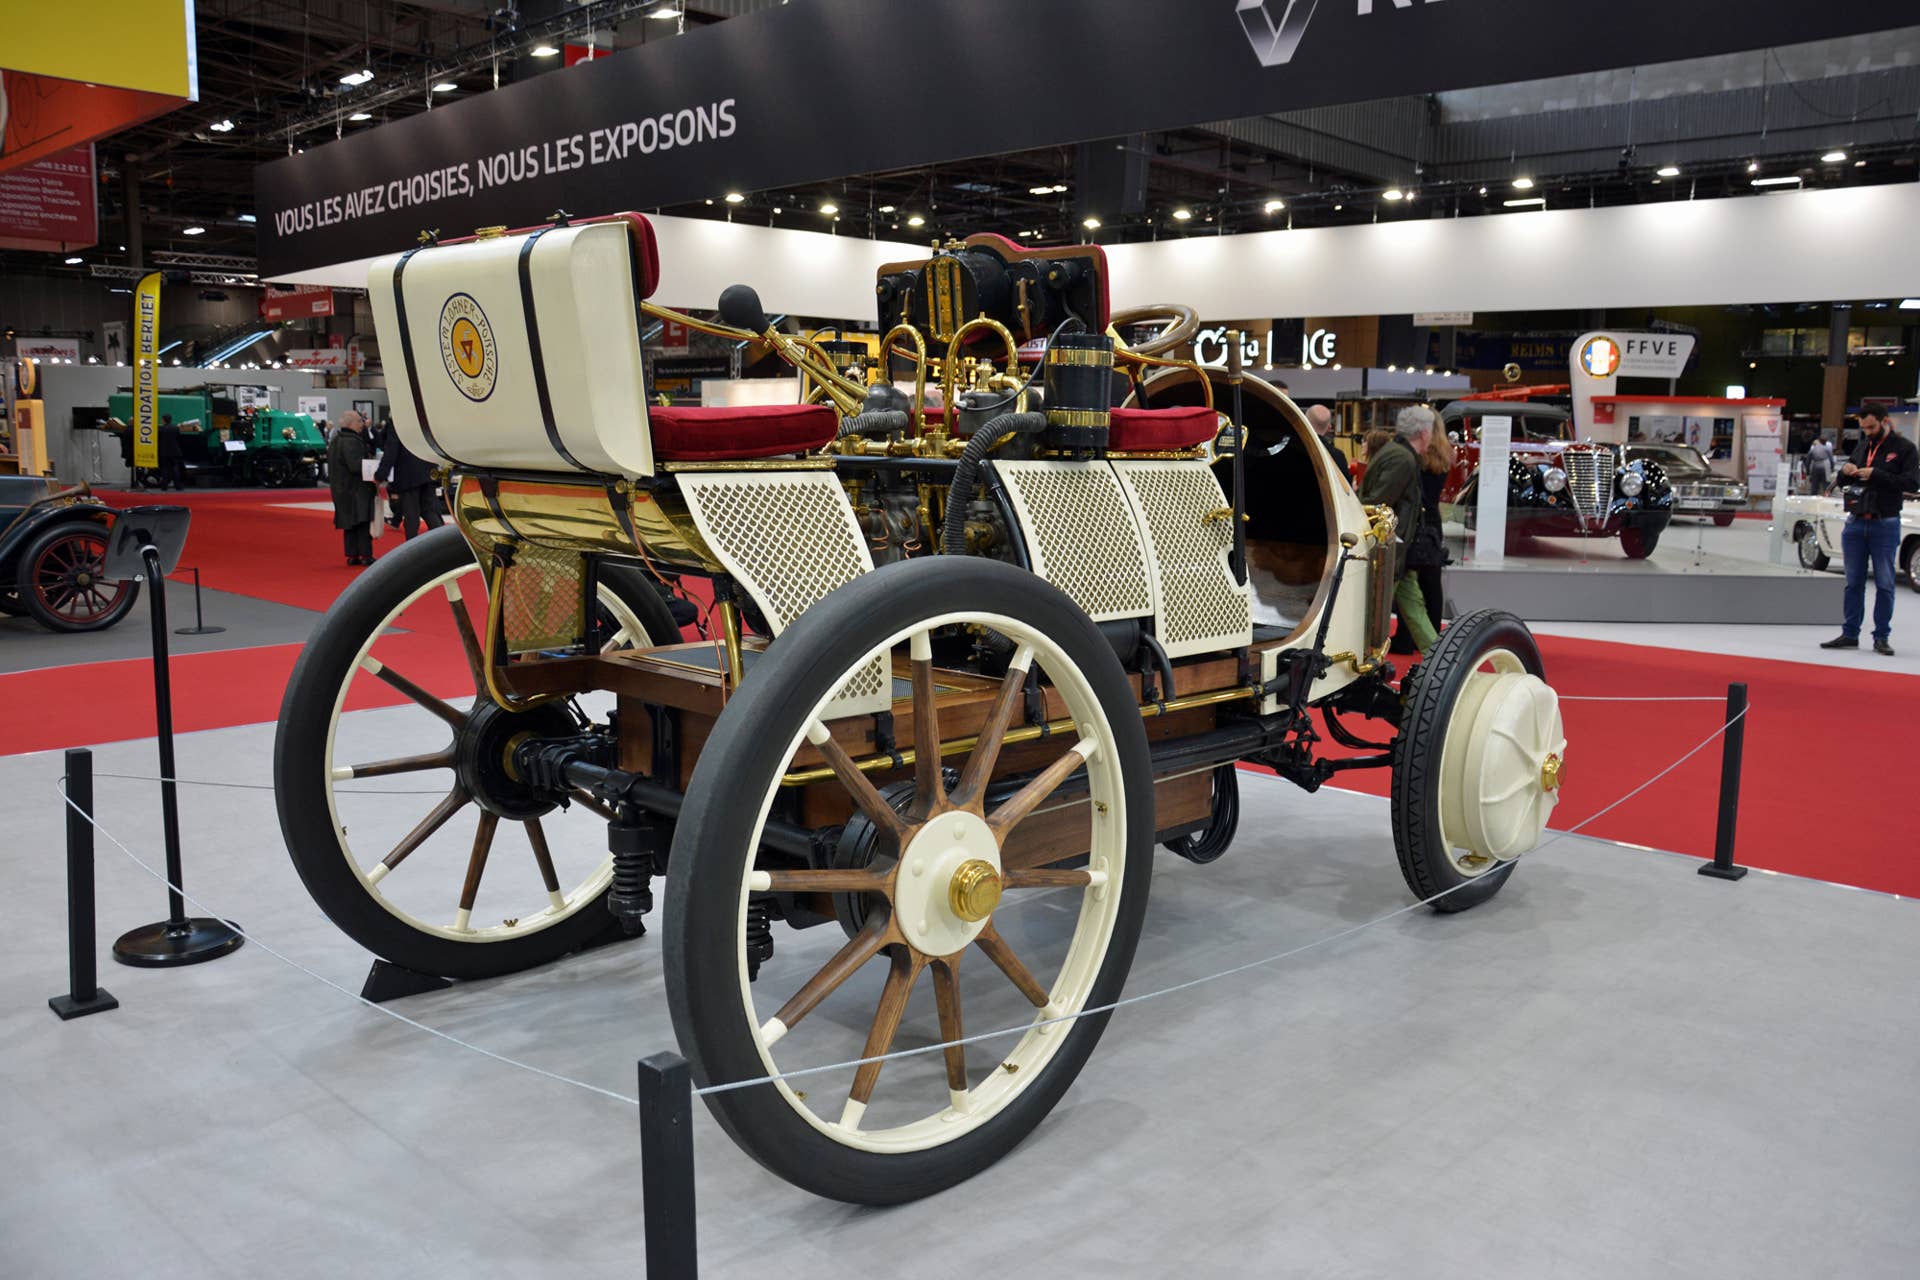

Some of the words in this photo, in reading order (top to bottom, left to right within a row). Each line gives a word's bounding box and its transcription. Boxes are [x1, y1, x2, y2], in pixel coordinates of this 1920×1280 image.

[274, 203, 313, 237] VOUS
[316, 195, 342, 227] LES
[345, 185, 385, 221] AVEZ
[388, 163, 475, 210] CHOISIES,
[478, 146, 539, 189] NOUS
[543, 134, 584, 175] LES
[589, 98, 737, 165] EXPOSONS
[141, 293, 154, 354] BERLIET
[1626, 339, 1678, 356] FFVE
[140, 359, 153, 445] FONDATION
